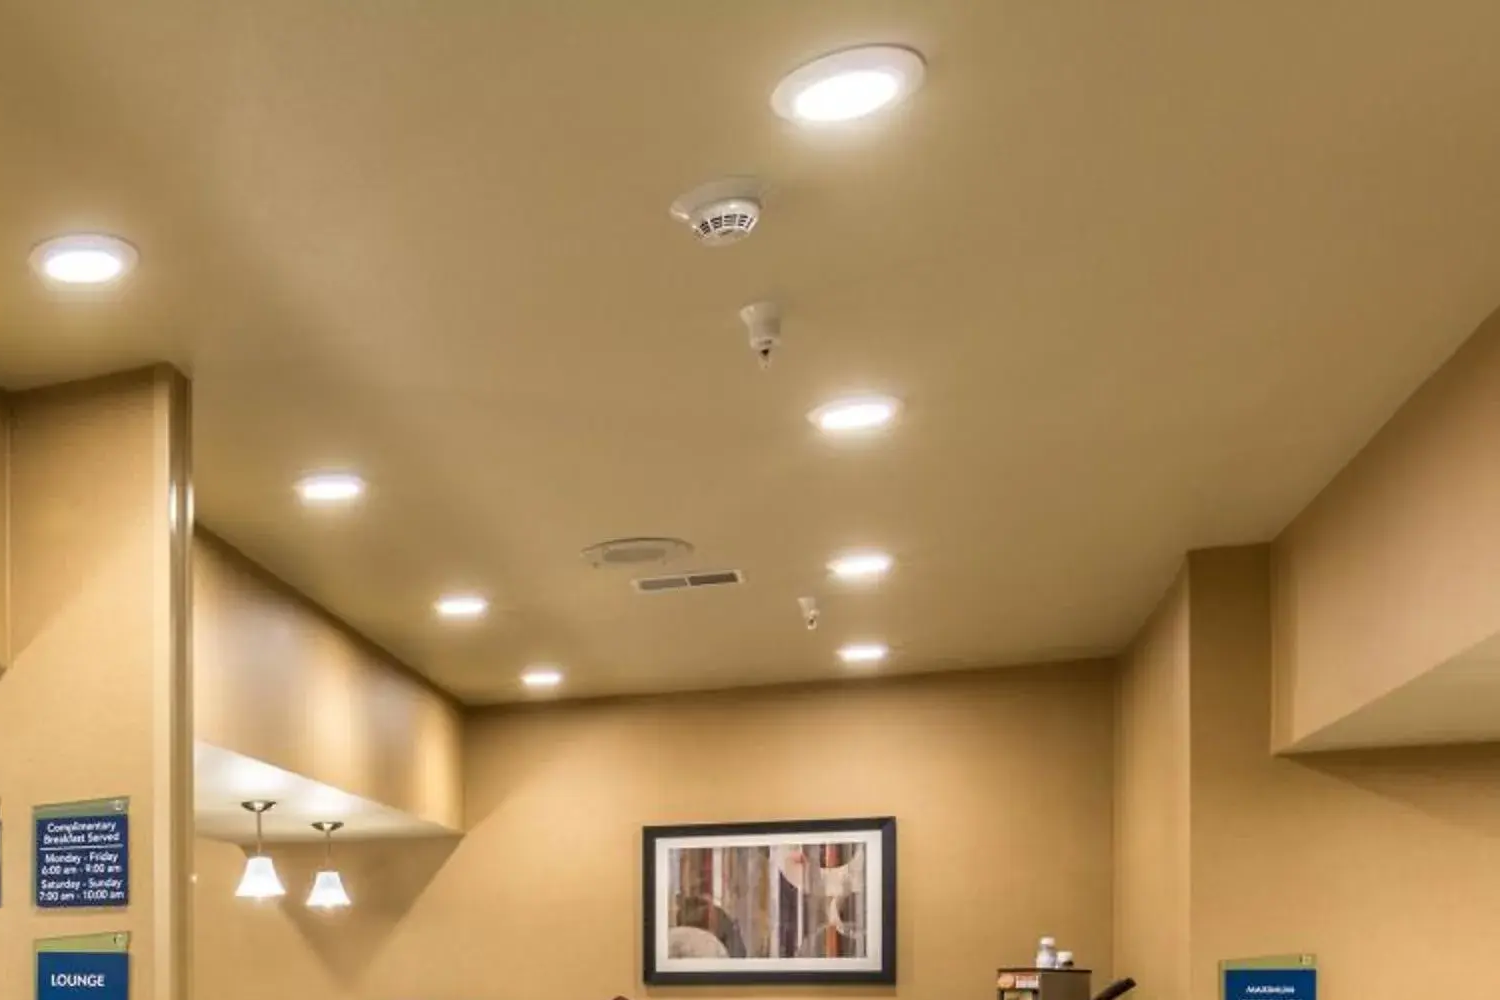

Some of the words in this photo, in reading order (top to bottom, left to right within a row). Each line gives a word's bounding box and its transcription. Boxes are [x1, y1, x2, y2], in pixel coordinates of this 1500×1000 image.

[47, 821, 116, 833] Complimentary
[43, 833, 85, 844] Breakfast
[87, 832, 120, 843] Served
[45, 853, 80, 864] Monday
[89, 852, 118, 862] Friday
[107, 865, 122, 873] am
[41, 879, 80, 890] Saturday
[88, 878, 122, 889] Sunday
[83, 890, 108, 900] 10:00
[110, 891, 125, 899] am
[51, 973, 105, 987] LOUNGE
[1245, 985, 1295, 994] MAXIMUM
